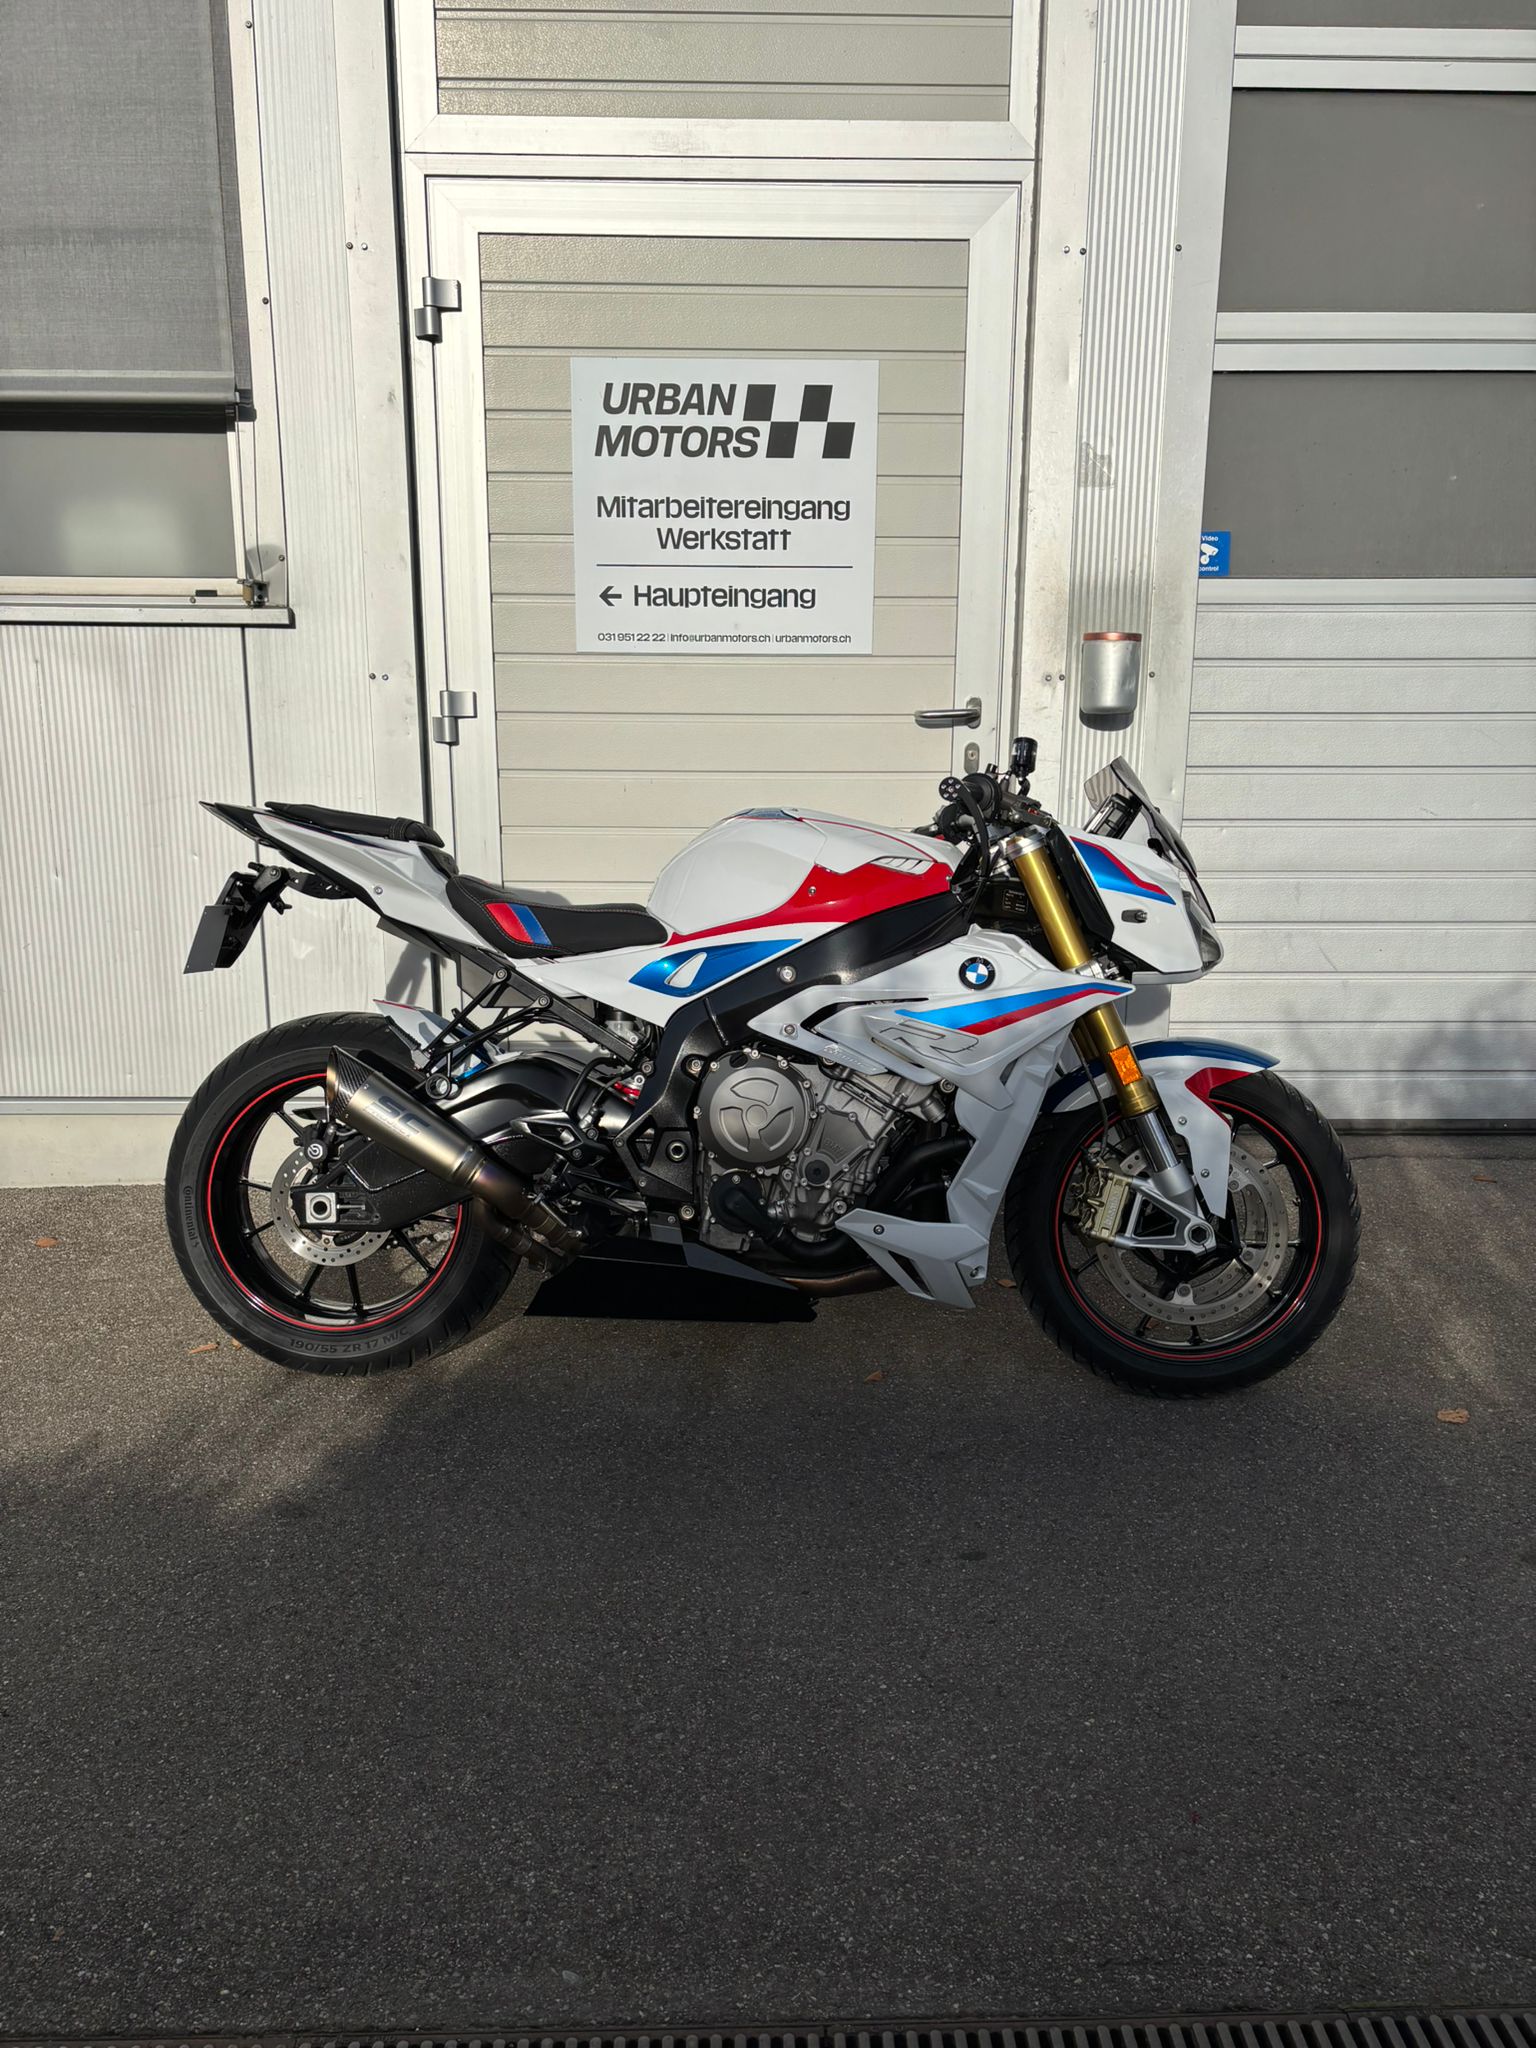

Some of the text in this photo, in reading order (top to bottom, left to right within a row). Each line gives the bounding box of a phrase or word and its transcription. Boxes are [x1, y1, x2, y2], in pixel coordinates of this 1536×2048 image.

[602, 382, 737, 416] URBAN
[594, 424, 761, 459] MOTORS
[596, 495, 851, 521] Mitarbeitereingang
[656, 527, 792, 551] Werkstatt
[633, 584, 816, 609] Haupteingang
[775, 634, 852, 643] urbanmotors.ch
[183, 1185, 198, 1240] Continental
[289, 1326, 409, 1353] 190/55 ZR 17 M/C
